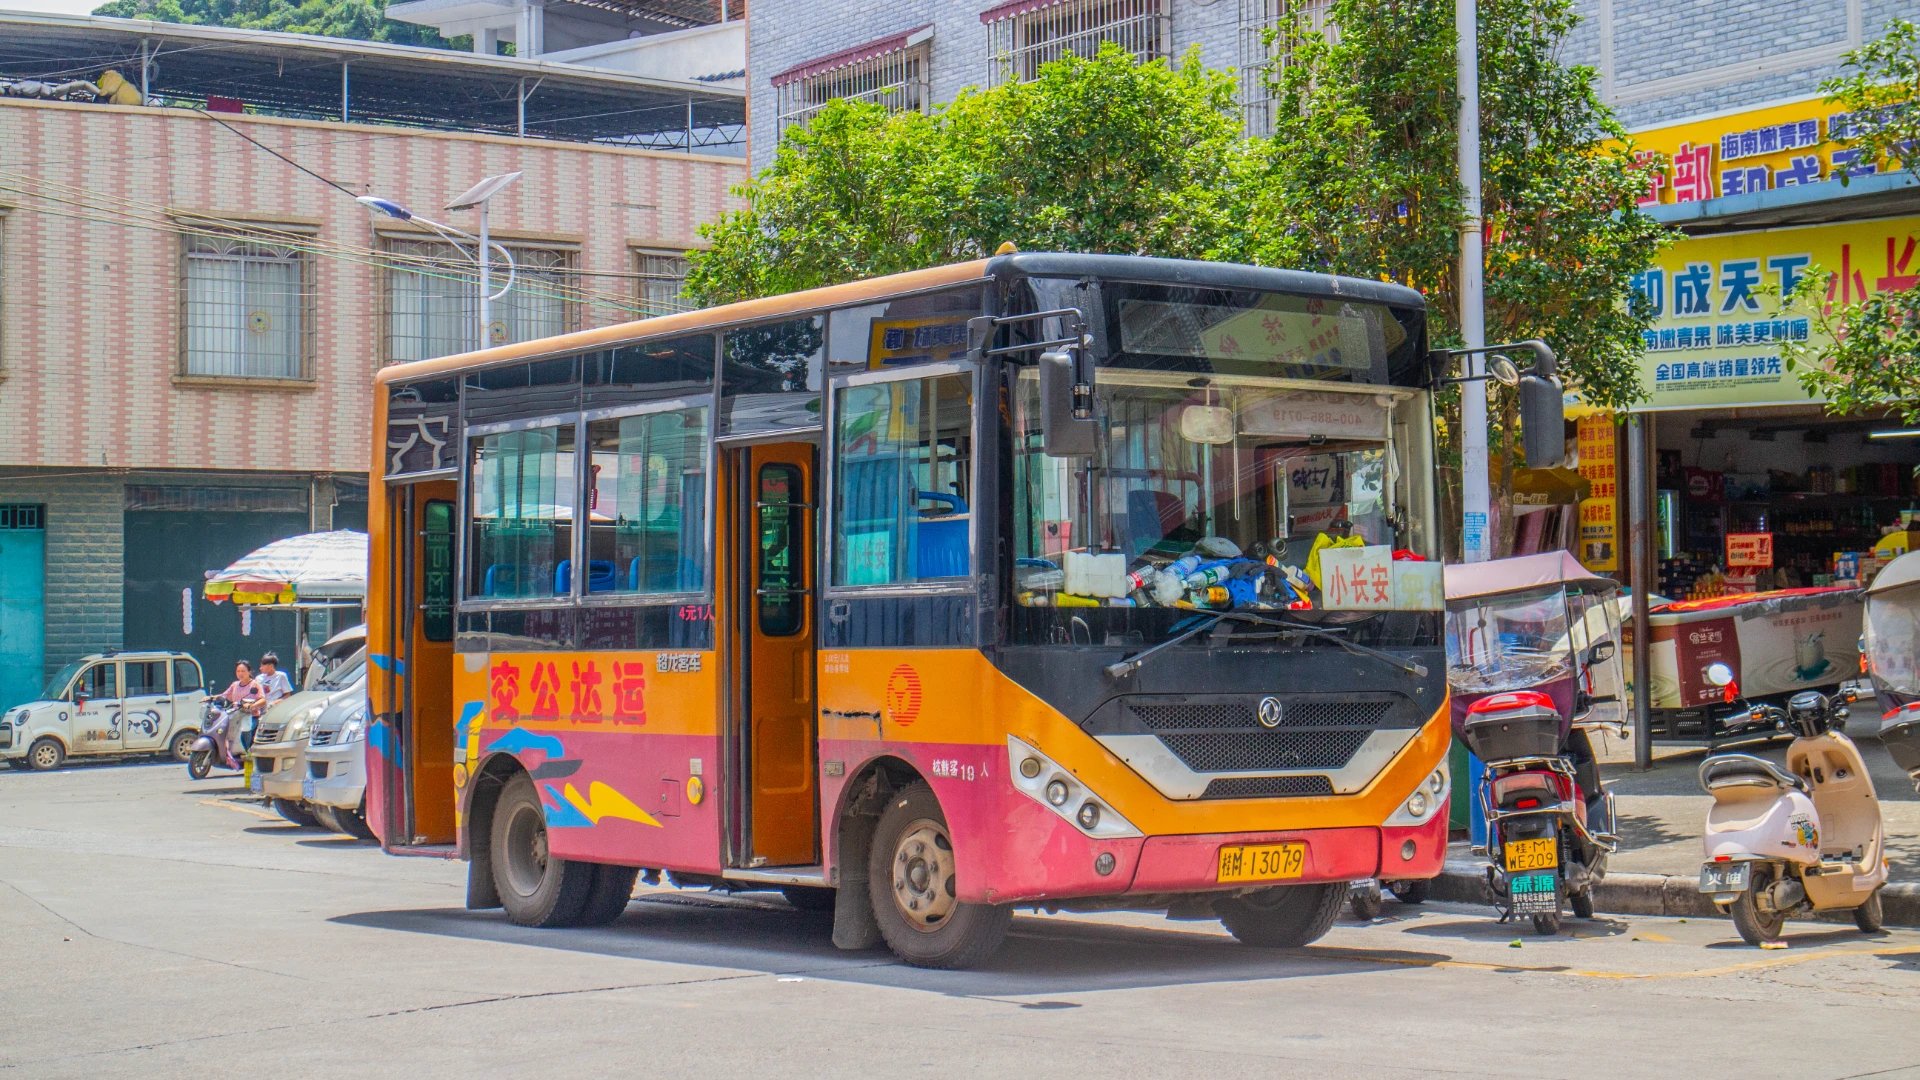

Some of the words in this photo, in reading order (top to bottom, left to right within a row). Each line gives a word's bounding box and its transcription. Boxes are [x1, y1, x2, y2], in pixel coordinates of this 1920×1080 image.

[1720, 118, 1819, 161] 海南嫩青果
[1716, 318, 1809, 347] 味美更耐嚼
[1655, 356, 1782, 381] 全国高端销量领先
[1598, 426, 1613, 440] 饮料
[1329, 563, 1391, 605] 小长安
[678, 604, 715, 621] 4元1人
[656, 653, 702, 674] 超龙客车
[1509, 852, 1554, 870] WE209
[1511, 874, 1555, 893] 绿源
